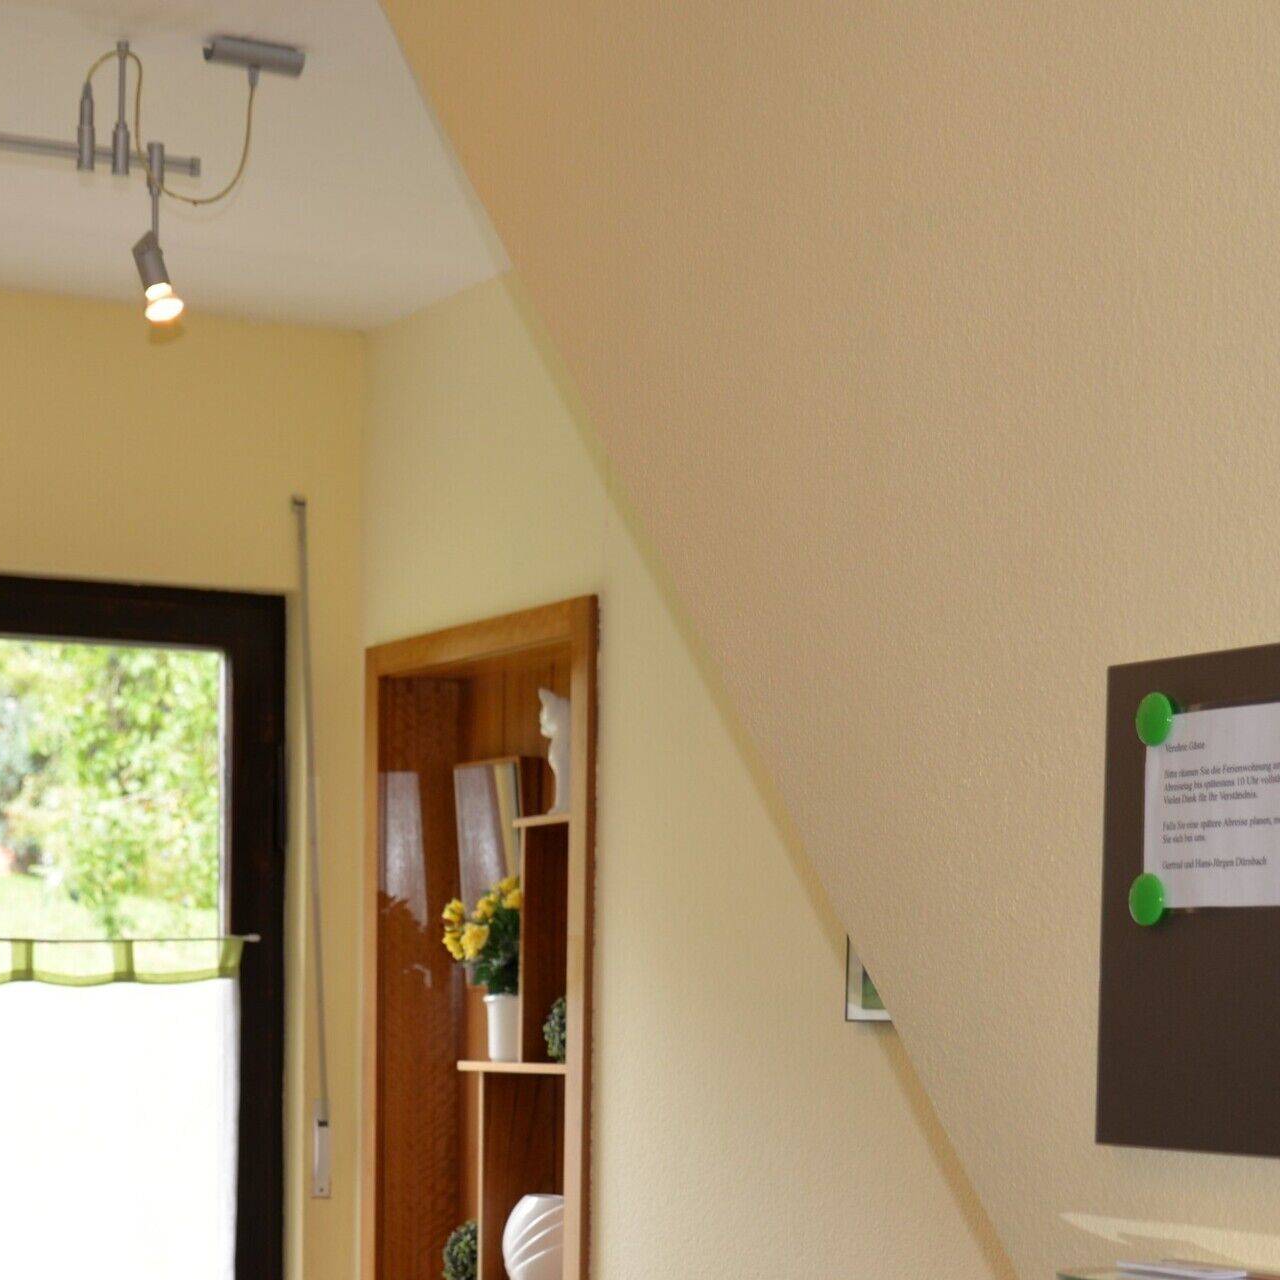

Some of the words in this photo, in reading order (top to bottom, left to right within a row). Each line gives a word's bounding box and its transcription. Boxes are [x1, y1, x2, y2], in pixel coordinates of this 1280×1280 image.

[1200, 766, 1210, 776] Sie
[1211, 765, 1221, 775] die
[1222, 763, 1271, 774] Ferienwohnung
[1224, 817, 1248, 827] Abreise
